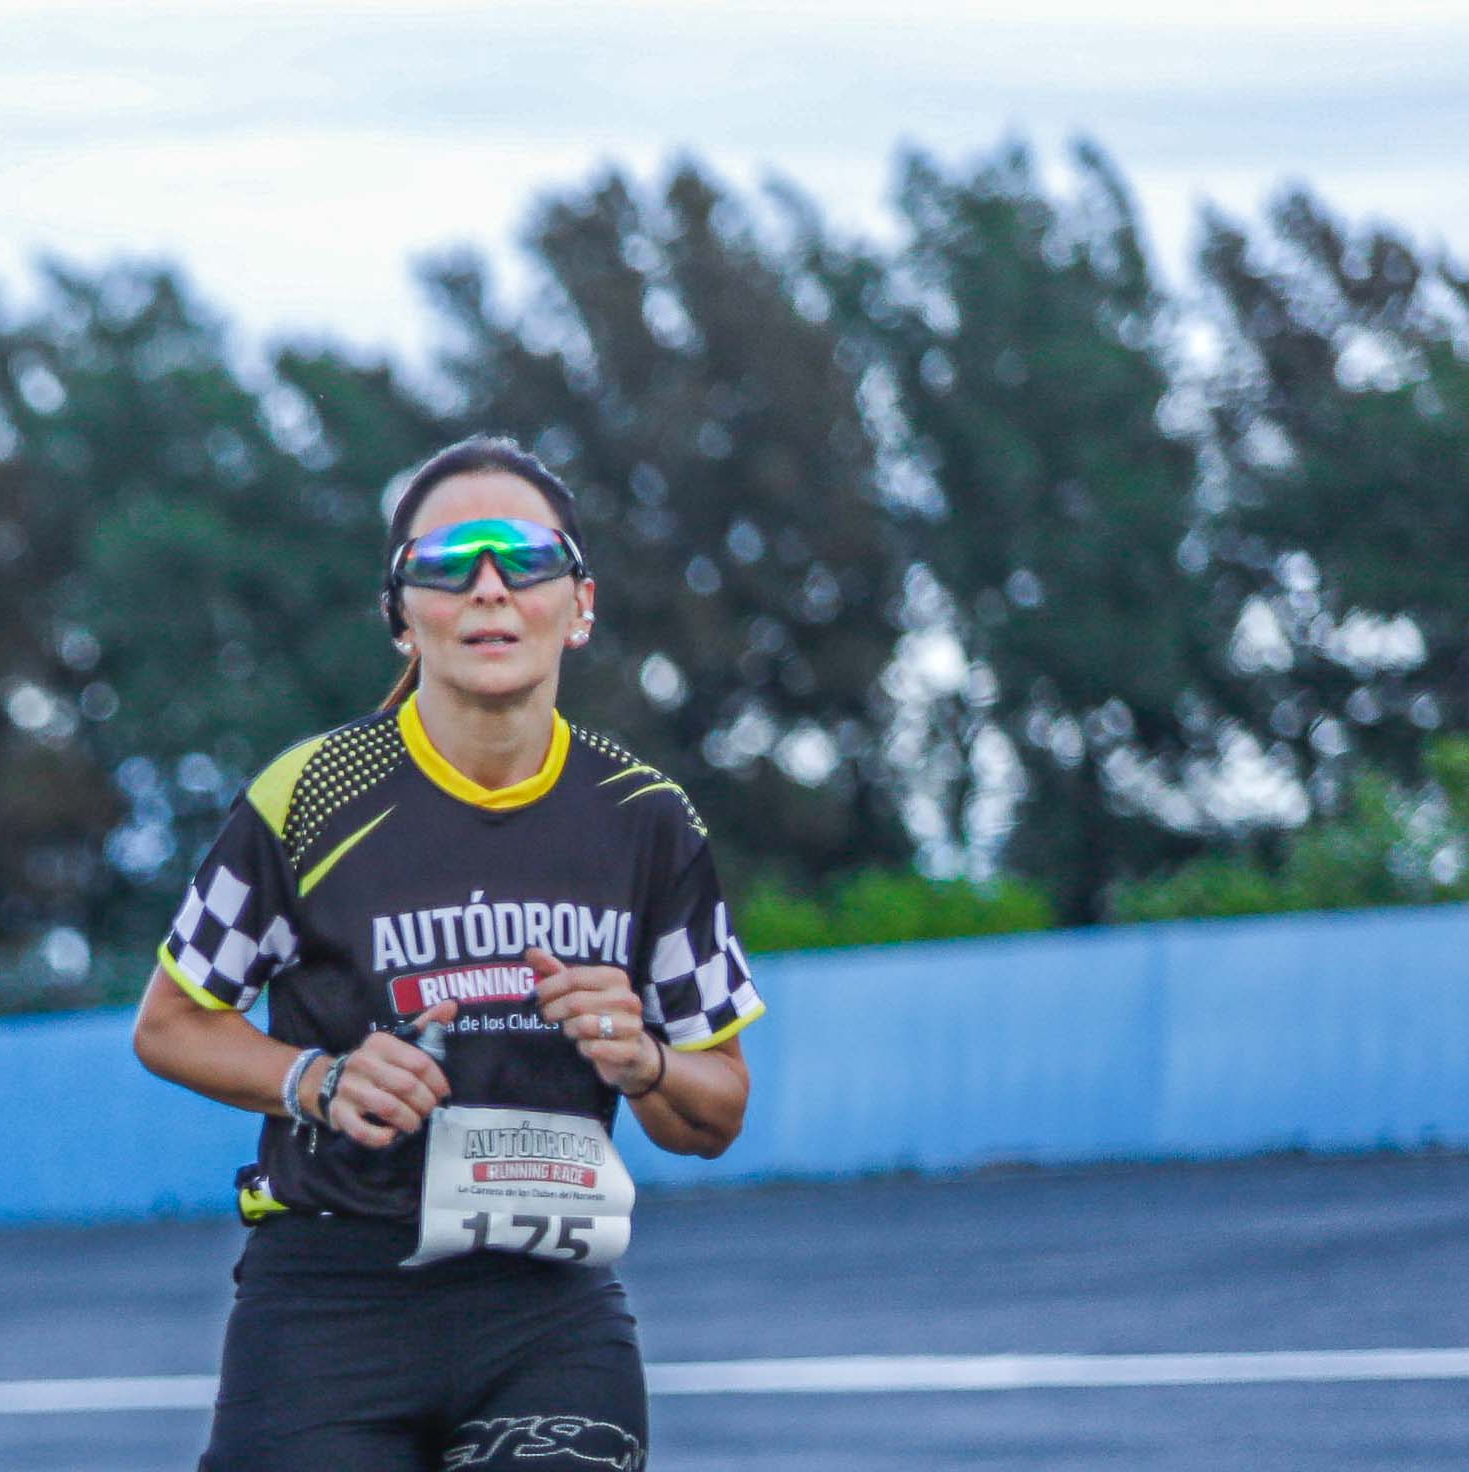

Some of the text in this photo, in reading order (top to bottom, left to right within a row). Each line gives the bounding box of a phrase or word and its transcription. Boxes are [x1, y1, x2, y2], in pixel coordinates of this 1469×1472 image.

[417, 966, 536, 1007] RUNNING
[460, 1016, 480, 1031] de
[484, 1015, 505, 1030] los
[464, 1120, 607, 1167] AUTÓDROMO
[488, 1163, 550, 1181] RUNNING
[462, 1211, 594, 1260] 175
